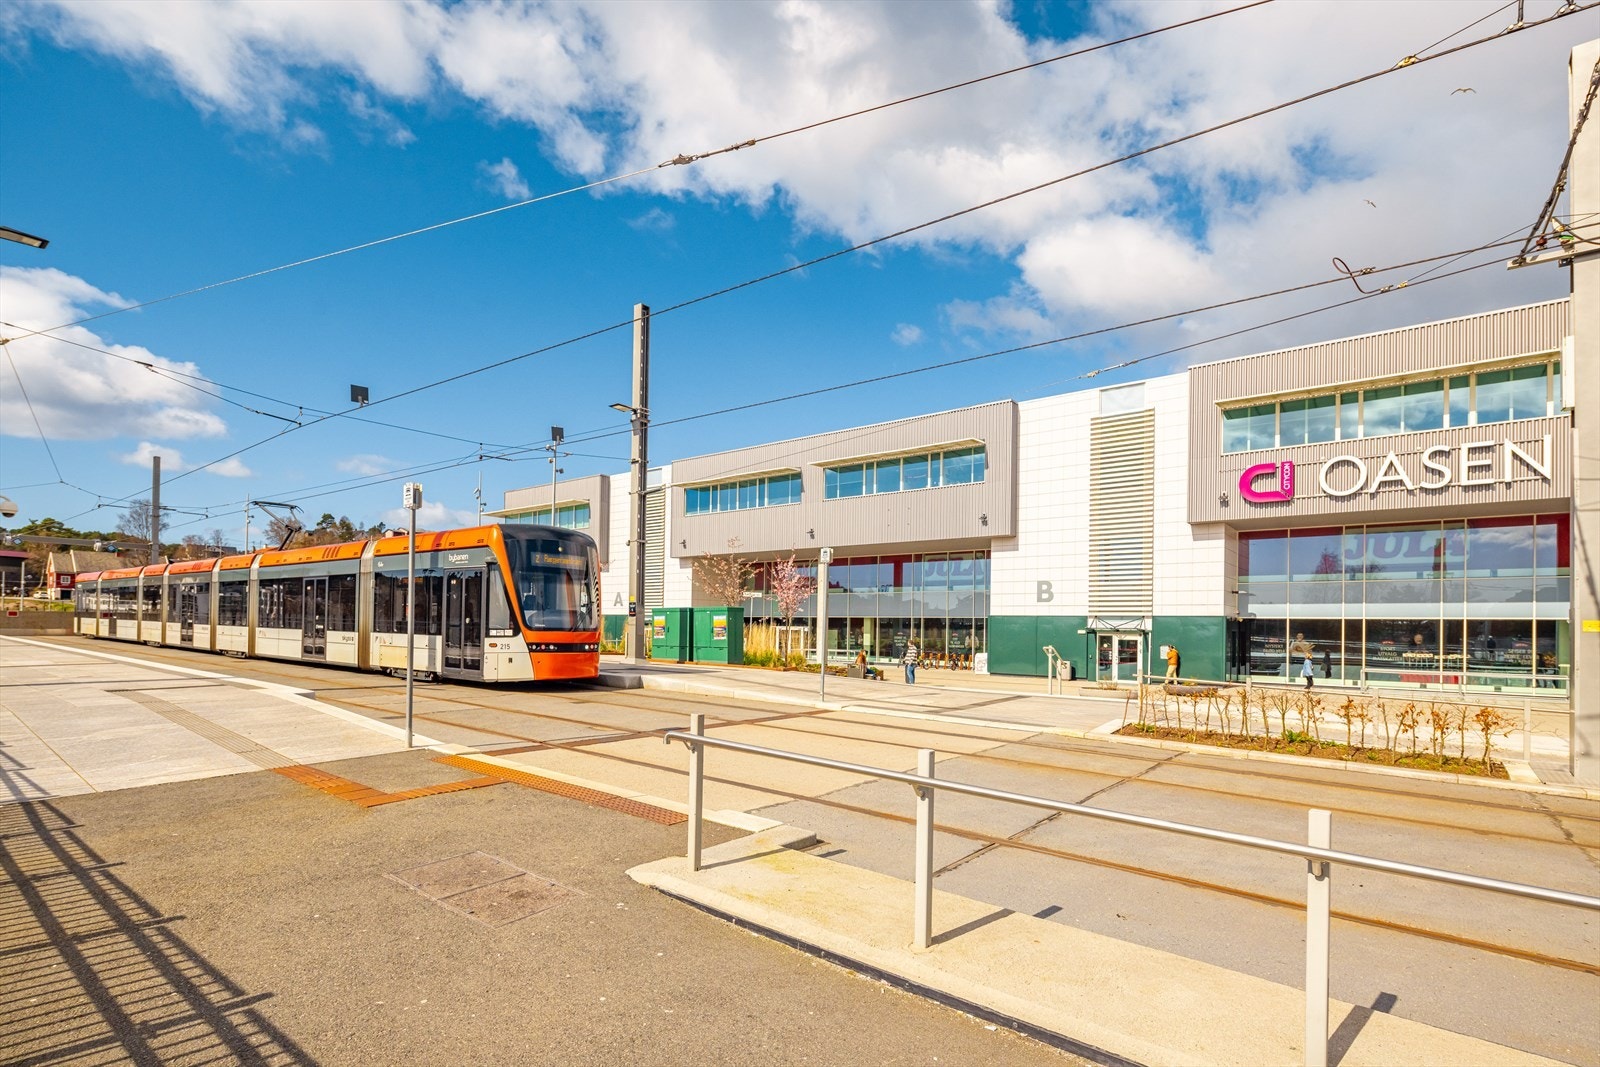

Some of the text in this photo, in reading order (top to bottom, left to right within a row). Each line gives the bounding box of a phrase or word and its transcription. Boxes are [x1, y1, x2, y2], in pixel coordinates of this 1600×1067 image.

[1283, 463, 1291, 490] CITYCON
[1319, 434, 1552, 497] OASEN
[1344, 532, 1468, 562] JULA
[613, 592, 624, 607] A
[1036, 580, 1055, 603] B
